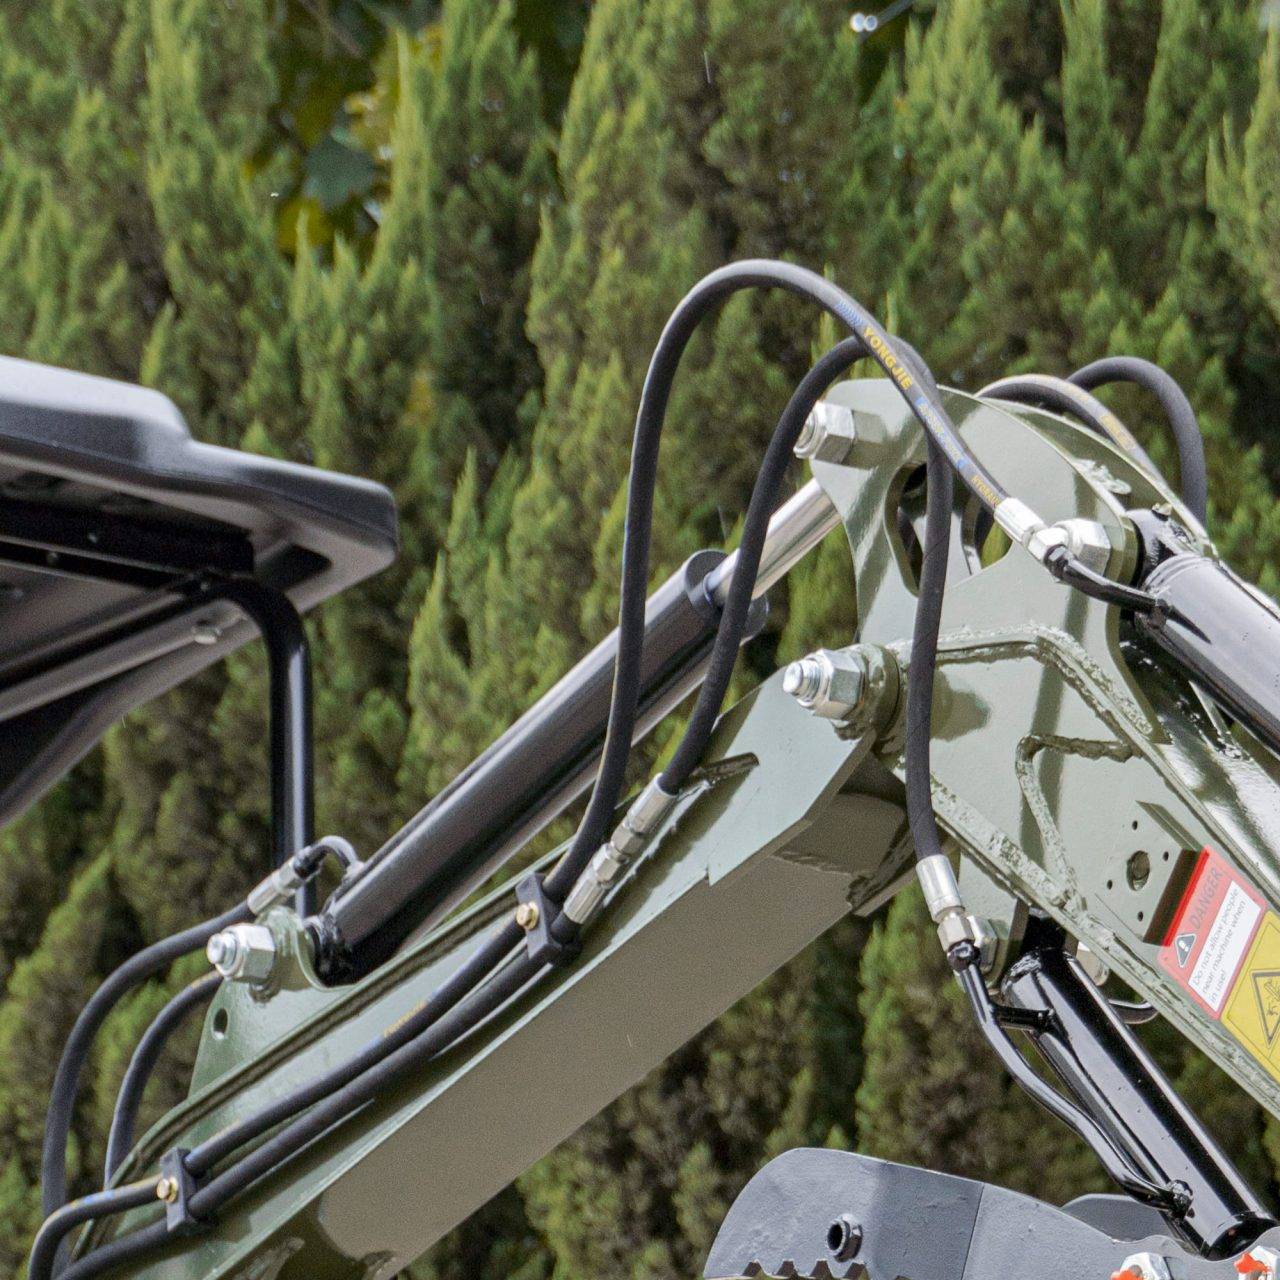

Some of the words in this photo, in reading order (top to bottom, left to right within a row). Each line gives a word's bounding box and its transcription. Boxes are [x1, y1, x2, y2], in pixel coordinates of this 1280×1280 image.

[863, 327, 914, 391] YONGJIE
[1189, 866, 1223, 931] DANGER
[1192, 969, 1204, 987] Do
[1201, 951, 1212, 970] not
[1211, 924, 1224, 952] allow
[1221, 887, 1240, 925] people
[1202, 971, 1214, 993] near
[1212, 929, 1233, 972] machine
[1231, 900, 1246, 928] when
[1211, 992, 1218, 1003] in
